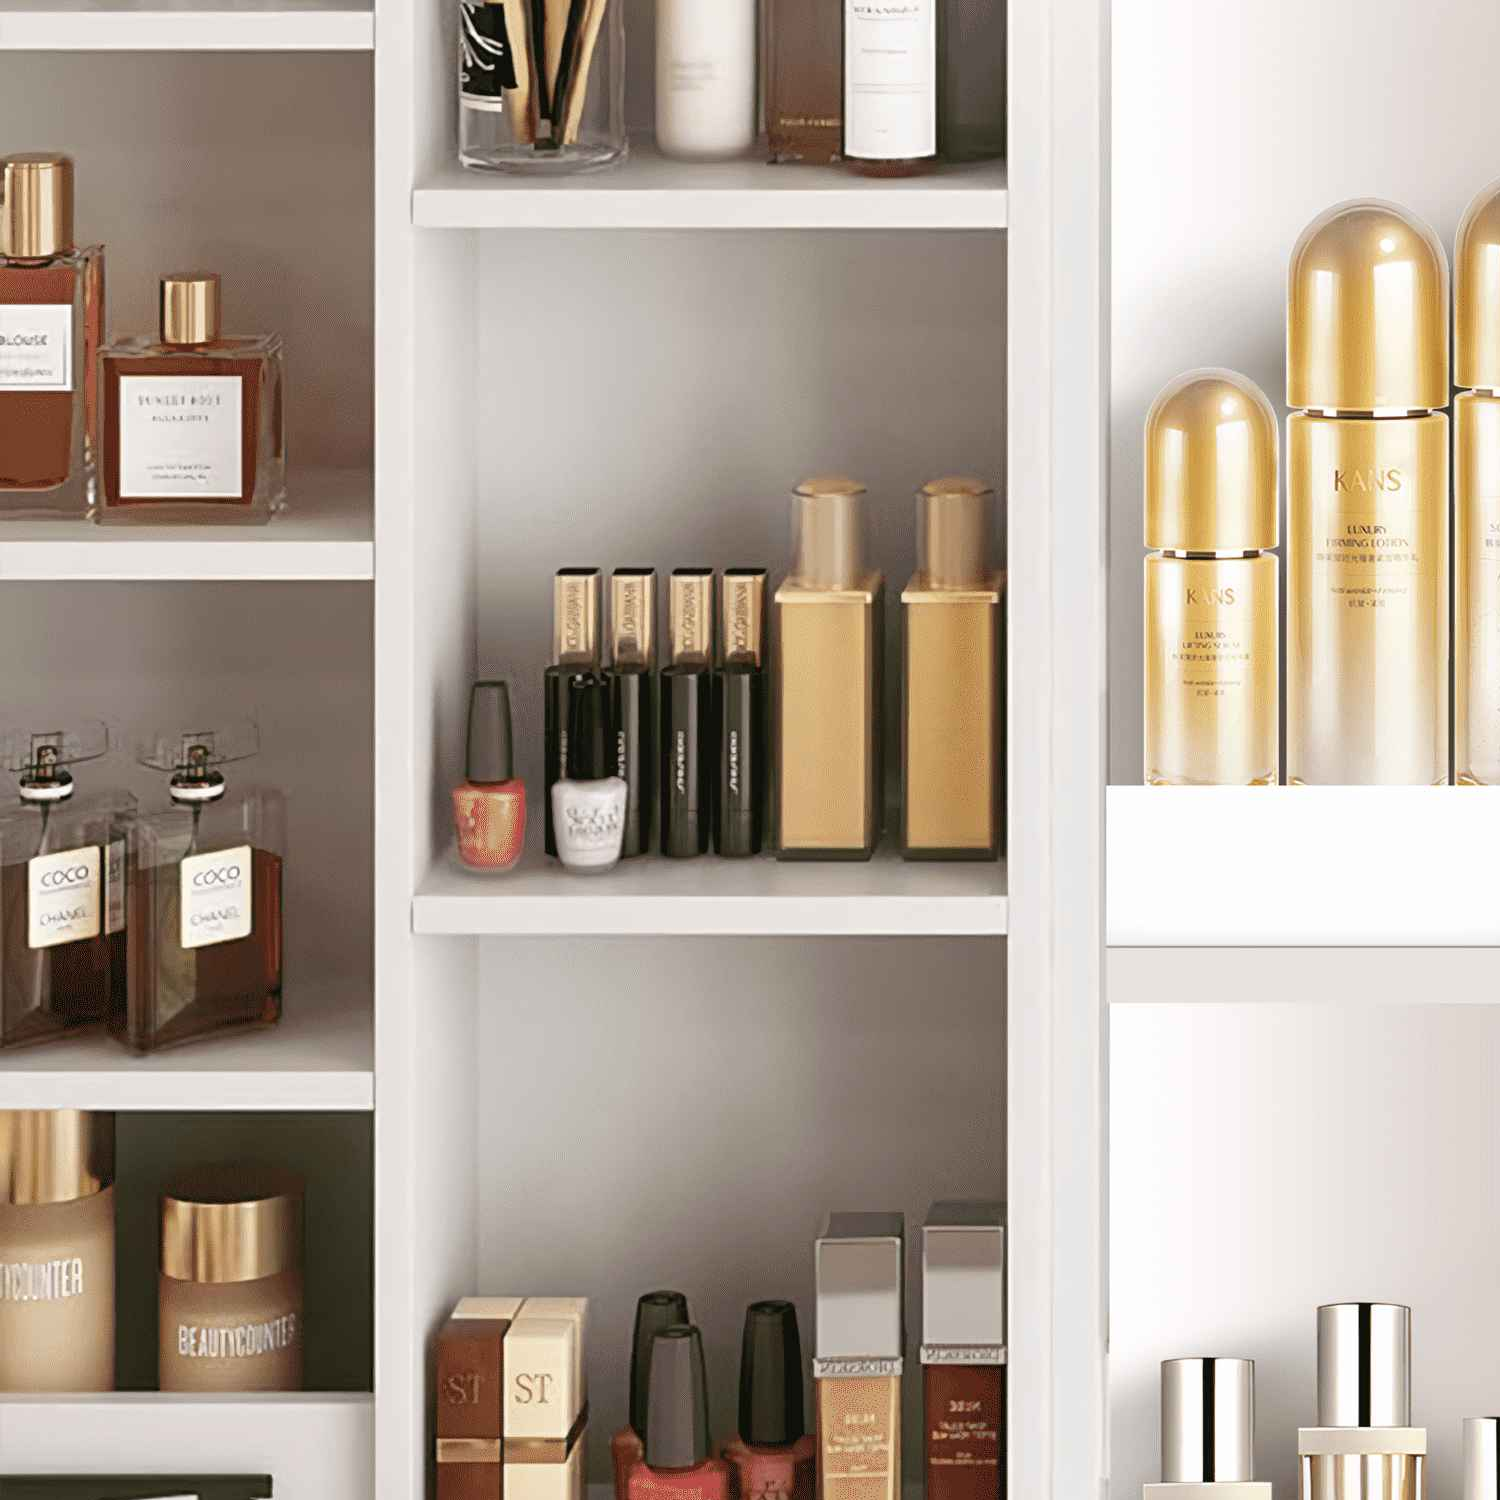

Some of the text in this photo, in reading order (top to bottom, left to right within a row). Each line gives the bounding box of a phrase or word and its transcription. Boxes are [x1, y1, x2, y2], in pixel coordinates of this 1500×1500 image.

[1334, 468, 1402, 492] KANS
[1186, 588, 1236, 606] KANS
[40, 864, 90, 888] COCO
[192, 864, 241, 888] COCO
[178, 1313, 296, 1357] BEAUTYCOUNTER
[514, 1372, 553, 1405] ST
